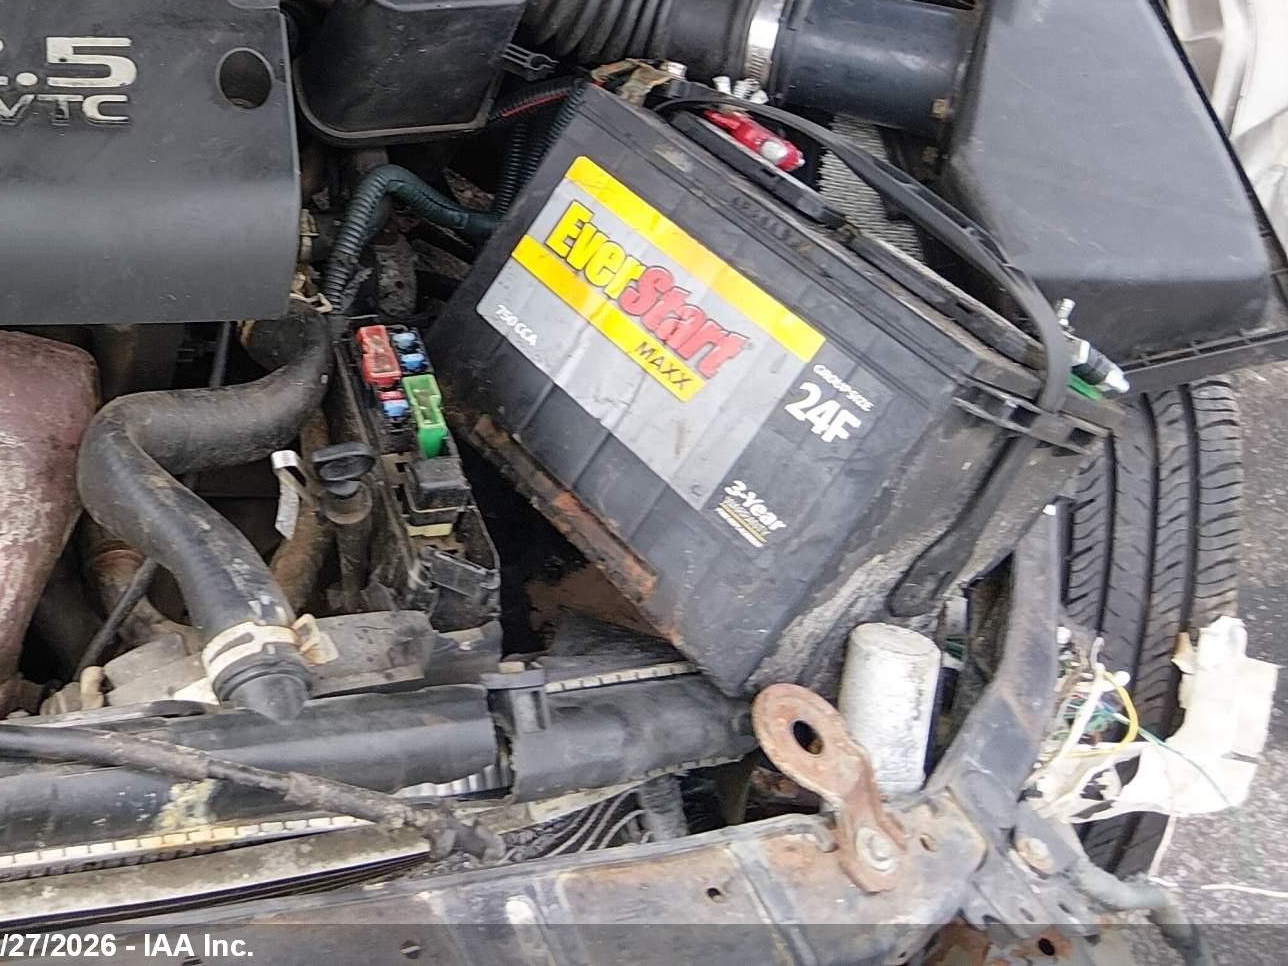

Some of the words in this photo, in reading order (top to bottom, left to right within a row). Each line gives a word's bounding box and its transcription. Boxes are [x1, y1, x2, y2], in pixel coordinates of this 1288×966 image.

[544, 199, 750, 379] EverStart
[635, 341, 692, 391] MAXX
[784, 381, 862, 443] 24F
[724, 480, 787, 531] 3-Year
